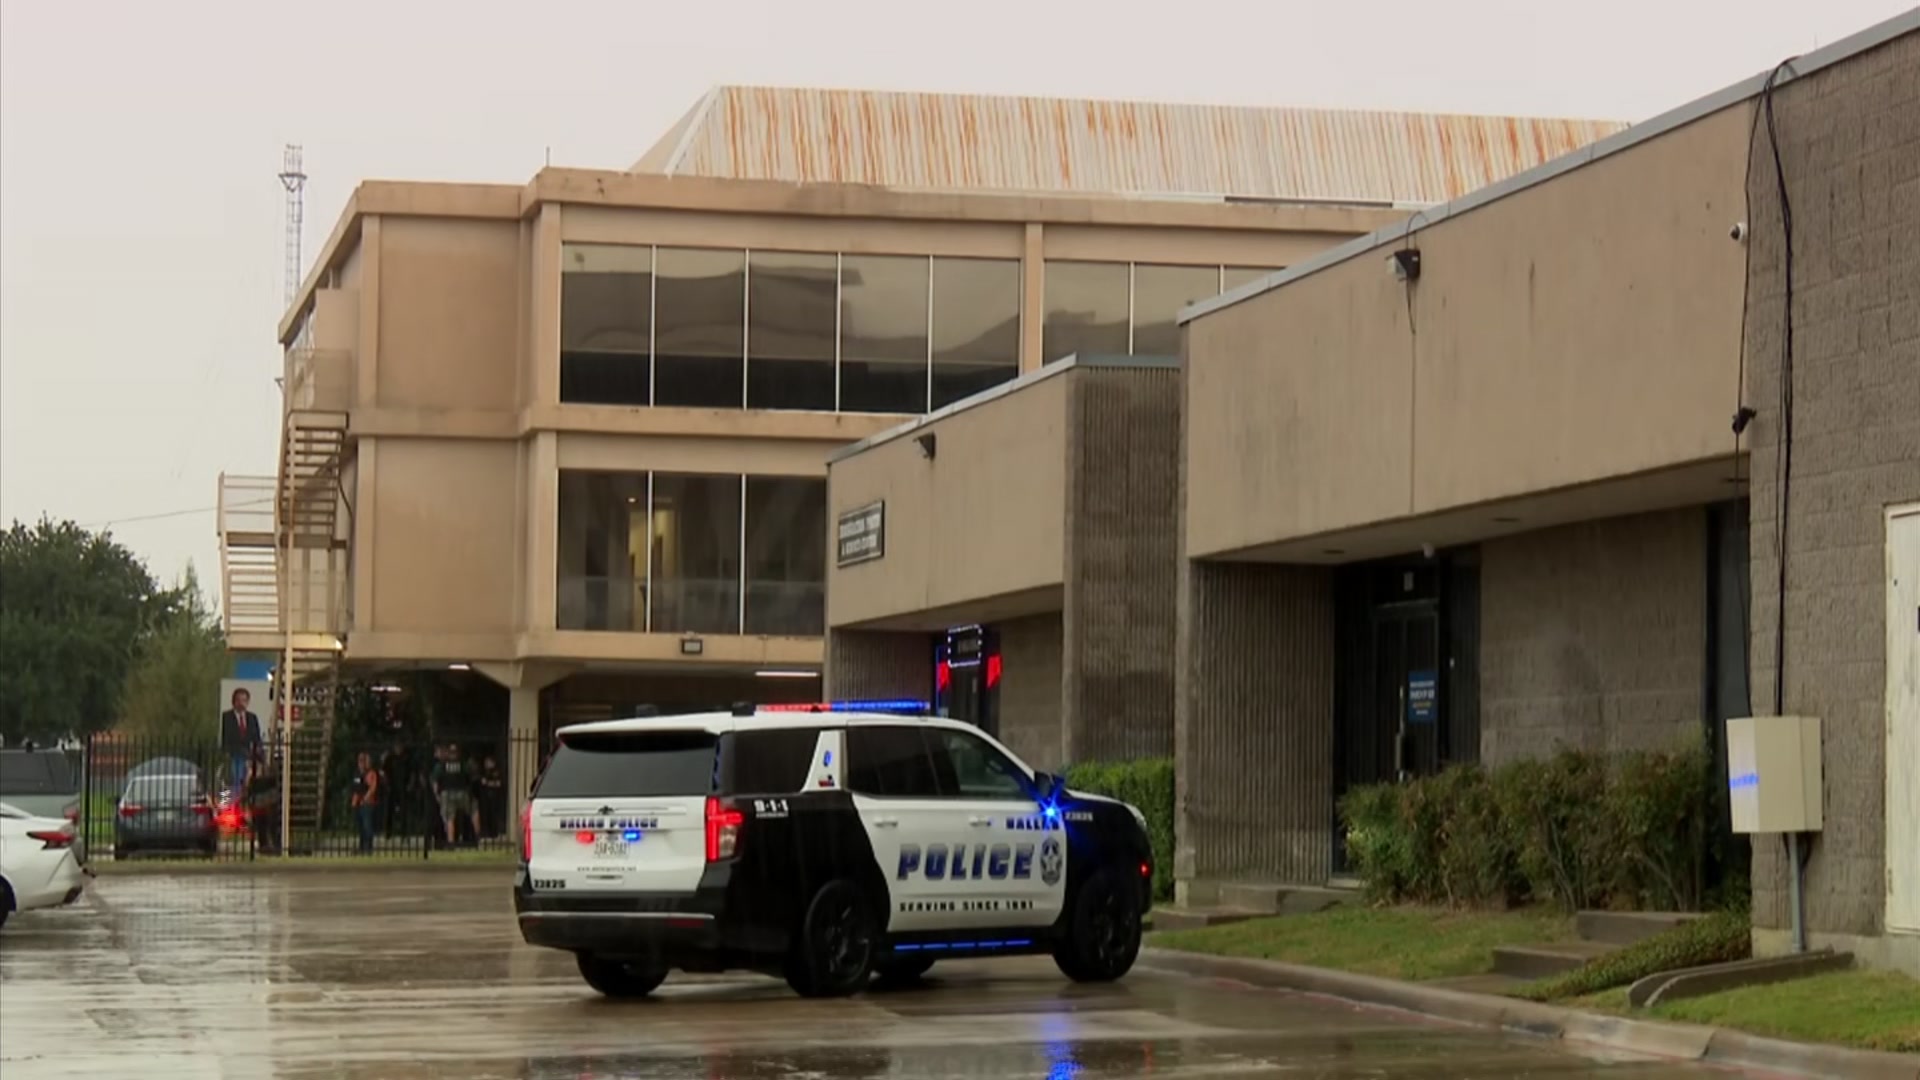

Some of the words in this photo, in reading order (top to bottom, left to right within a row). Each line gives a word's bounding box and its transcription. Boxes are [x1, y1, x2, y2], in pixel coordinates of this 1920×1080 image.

[609, 817, 658, 829] POLICE
[896, 842, 1035, 881] POLICE
[899, 901, 955, 912] SERVING
[962, 900, 999, 911] SINCE
